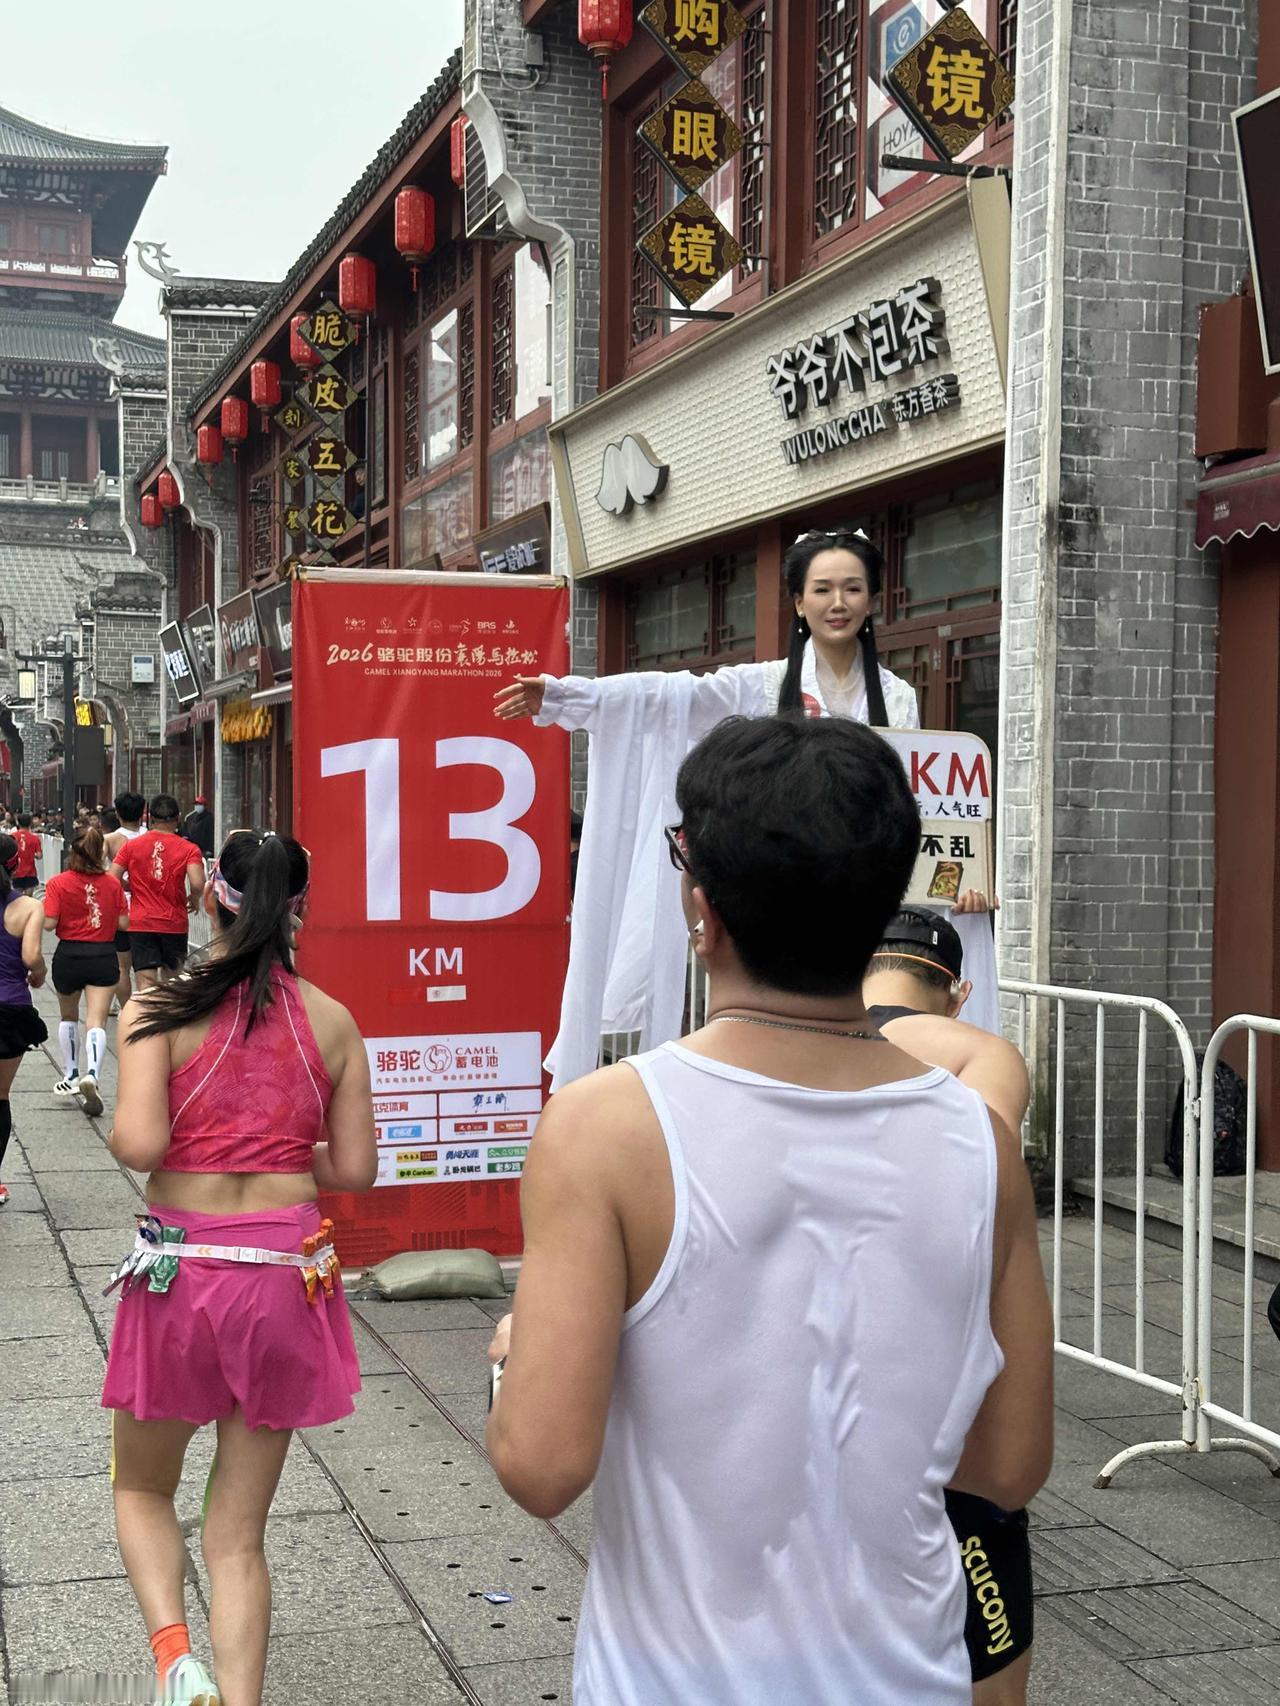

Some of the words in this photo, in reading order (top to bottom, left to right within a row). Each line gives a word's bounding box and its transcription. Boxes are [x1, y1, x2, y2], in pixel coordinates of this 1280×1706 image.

[926, 45, 985, 119] 镜
[766, 279, 941, 420] 爷爷不泡茶
[311, 314, 346, 535] 脆皮五花
[781, 404, 886, 464] WULONGCHA
[892, 378, 950, 422] 东方香茶
[326, 642, 375, 666] 2026
[364, 668, 391, 676] CAMEL
[393, 668, 439, 677] XIANGYANG
[440, 669, 484, 677] MARATHON
[485, 669, 502, 677] 2026
[911, 751, 989, 798] KM
[321, 736, 541, 921] 13
[920, 835, 975, 858] 不乱
[409, 947, 463, 977] KM
[377, 1049, 421, 1072] 骆驼
[455, 1046, 499, 1055] CAMEL
[455, 1055, 499, 1069] 蓄电池
